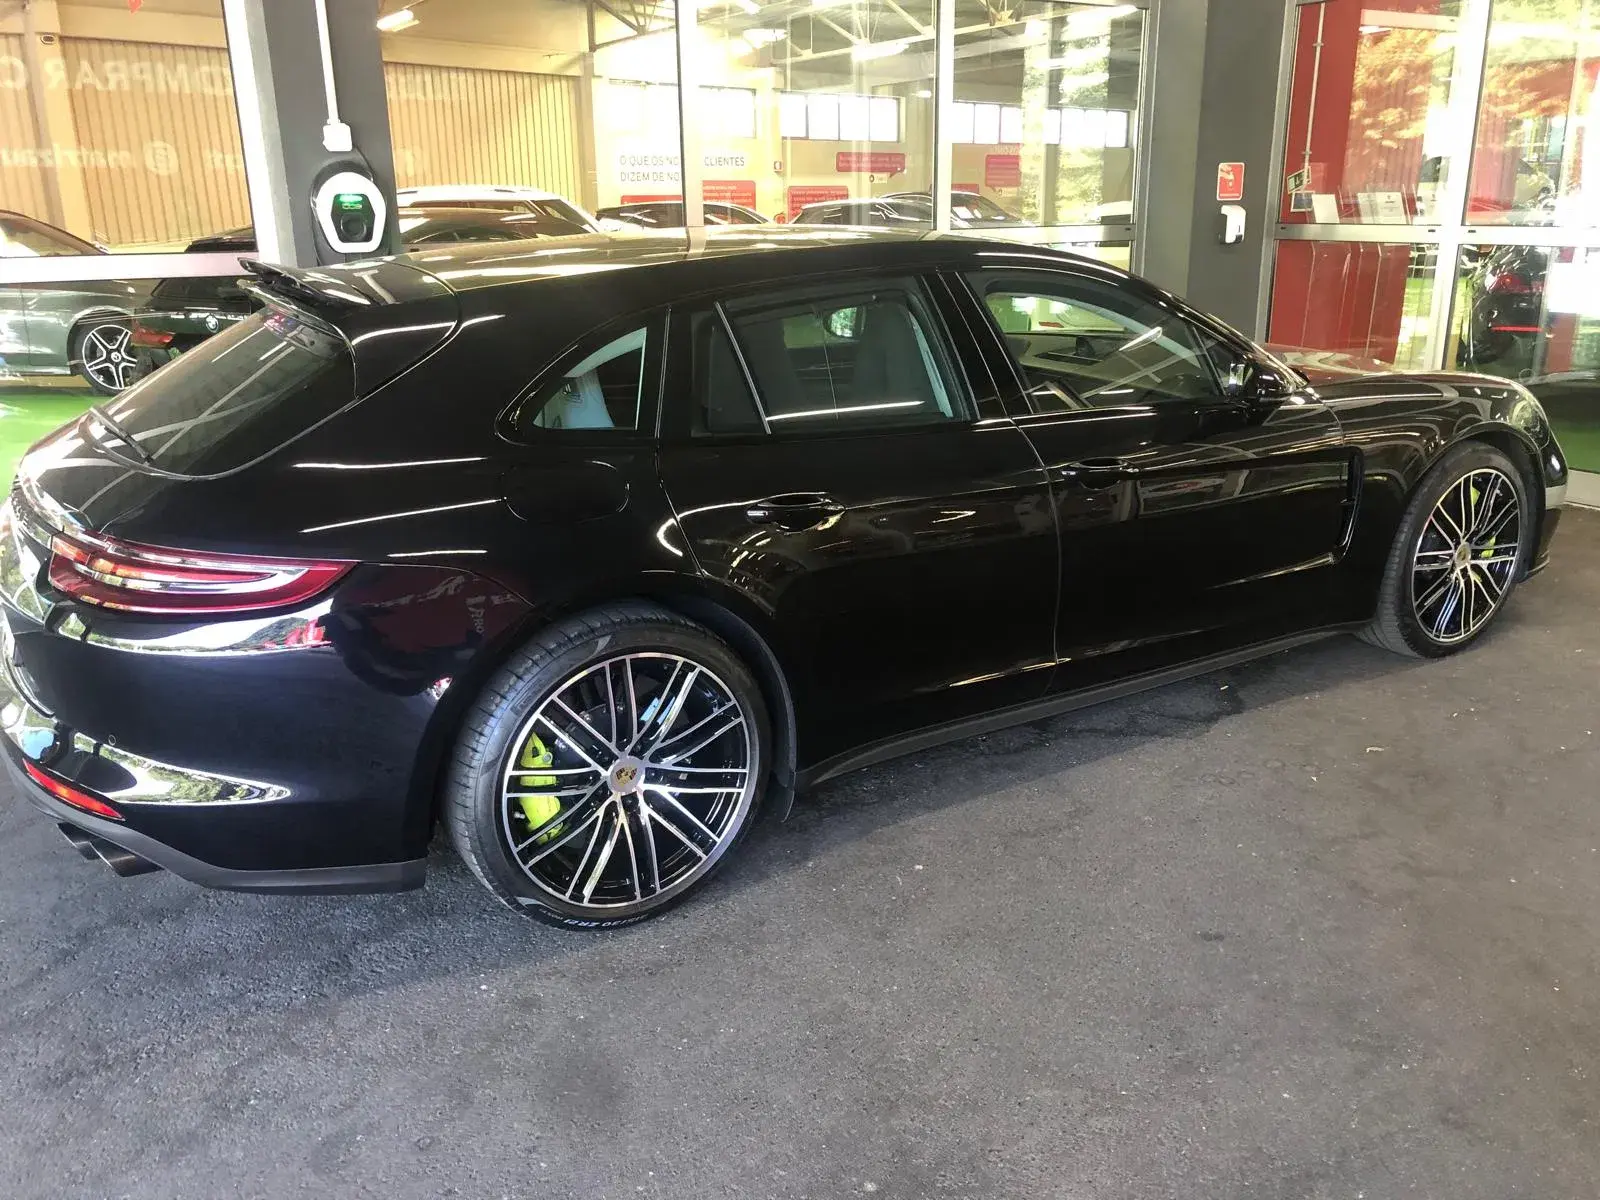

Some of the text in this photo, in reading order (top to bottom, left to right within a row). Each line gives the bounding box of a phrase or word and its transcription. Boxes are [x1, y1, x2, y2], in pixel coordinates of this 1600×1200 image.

[629, 155, 649, 167] QUE
[651, 155, 664, 166] OS
[704, 156, 745, 167] CLIENTES
[620, 171, 650, 182] DIZEM
[652, 171, 664, 182] DE
